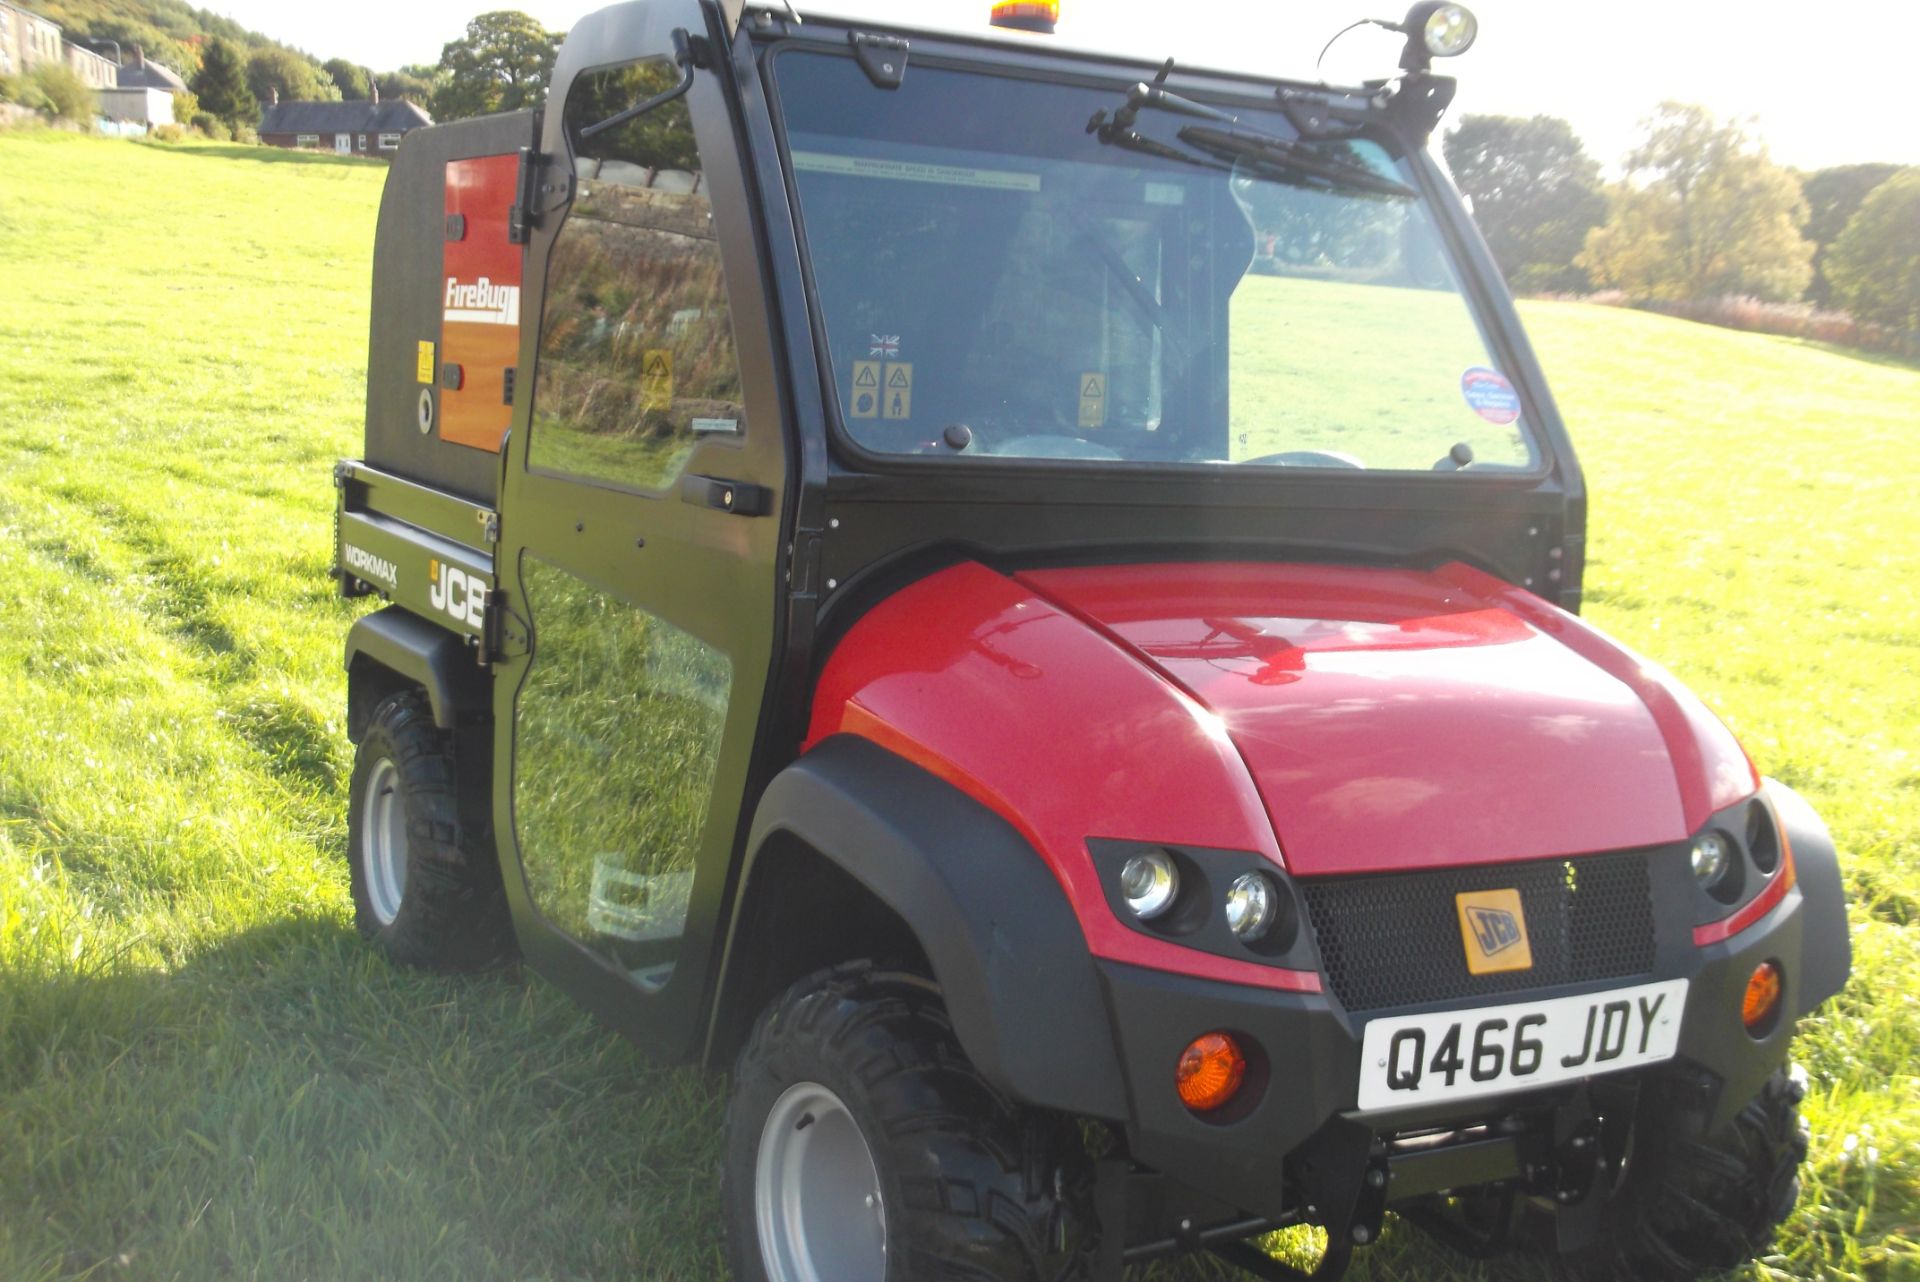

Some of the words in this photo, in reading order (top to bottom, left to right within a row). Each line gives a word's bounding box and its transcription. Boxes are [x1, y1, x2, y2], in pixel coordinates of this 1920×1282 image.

[445, 276, 509, 324] FireBug
[345, 543, 397, 584] WORKMAX
[1475, 910, 1518, 951] JCB
[1387, 1013, 1547, 1091] Q466
[1560, 993, 1666, 1068] JDY
